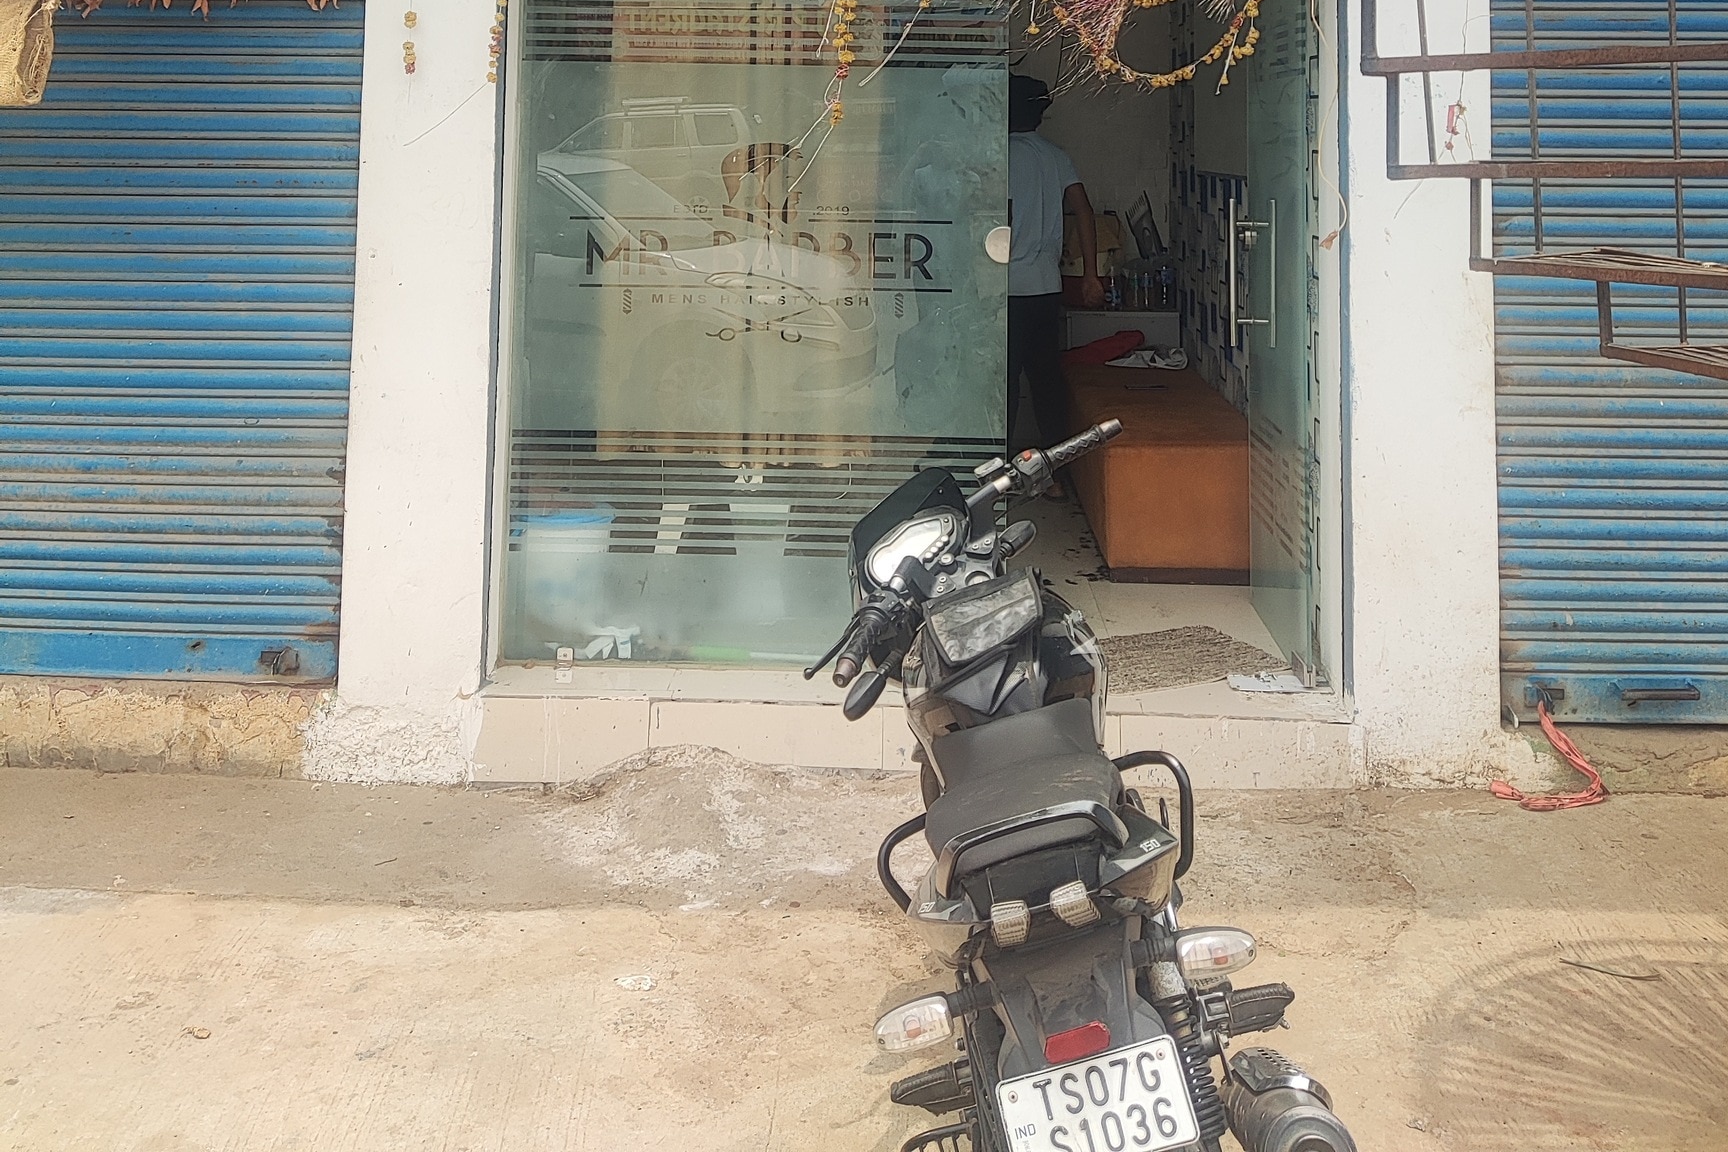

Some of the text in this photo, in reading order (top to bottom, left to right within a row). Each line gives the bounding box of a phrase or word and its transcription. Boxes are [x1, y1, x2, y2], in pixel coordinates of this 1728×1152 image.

[651, 293, 708, 305] MENS
[720, 294, 771, 306] HAI
[1032, 1051, 1162, 1121] TS07G
[1014, 1123, 1037, 1140] IND
[1049, 1097, 1178, 1152] S1036
